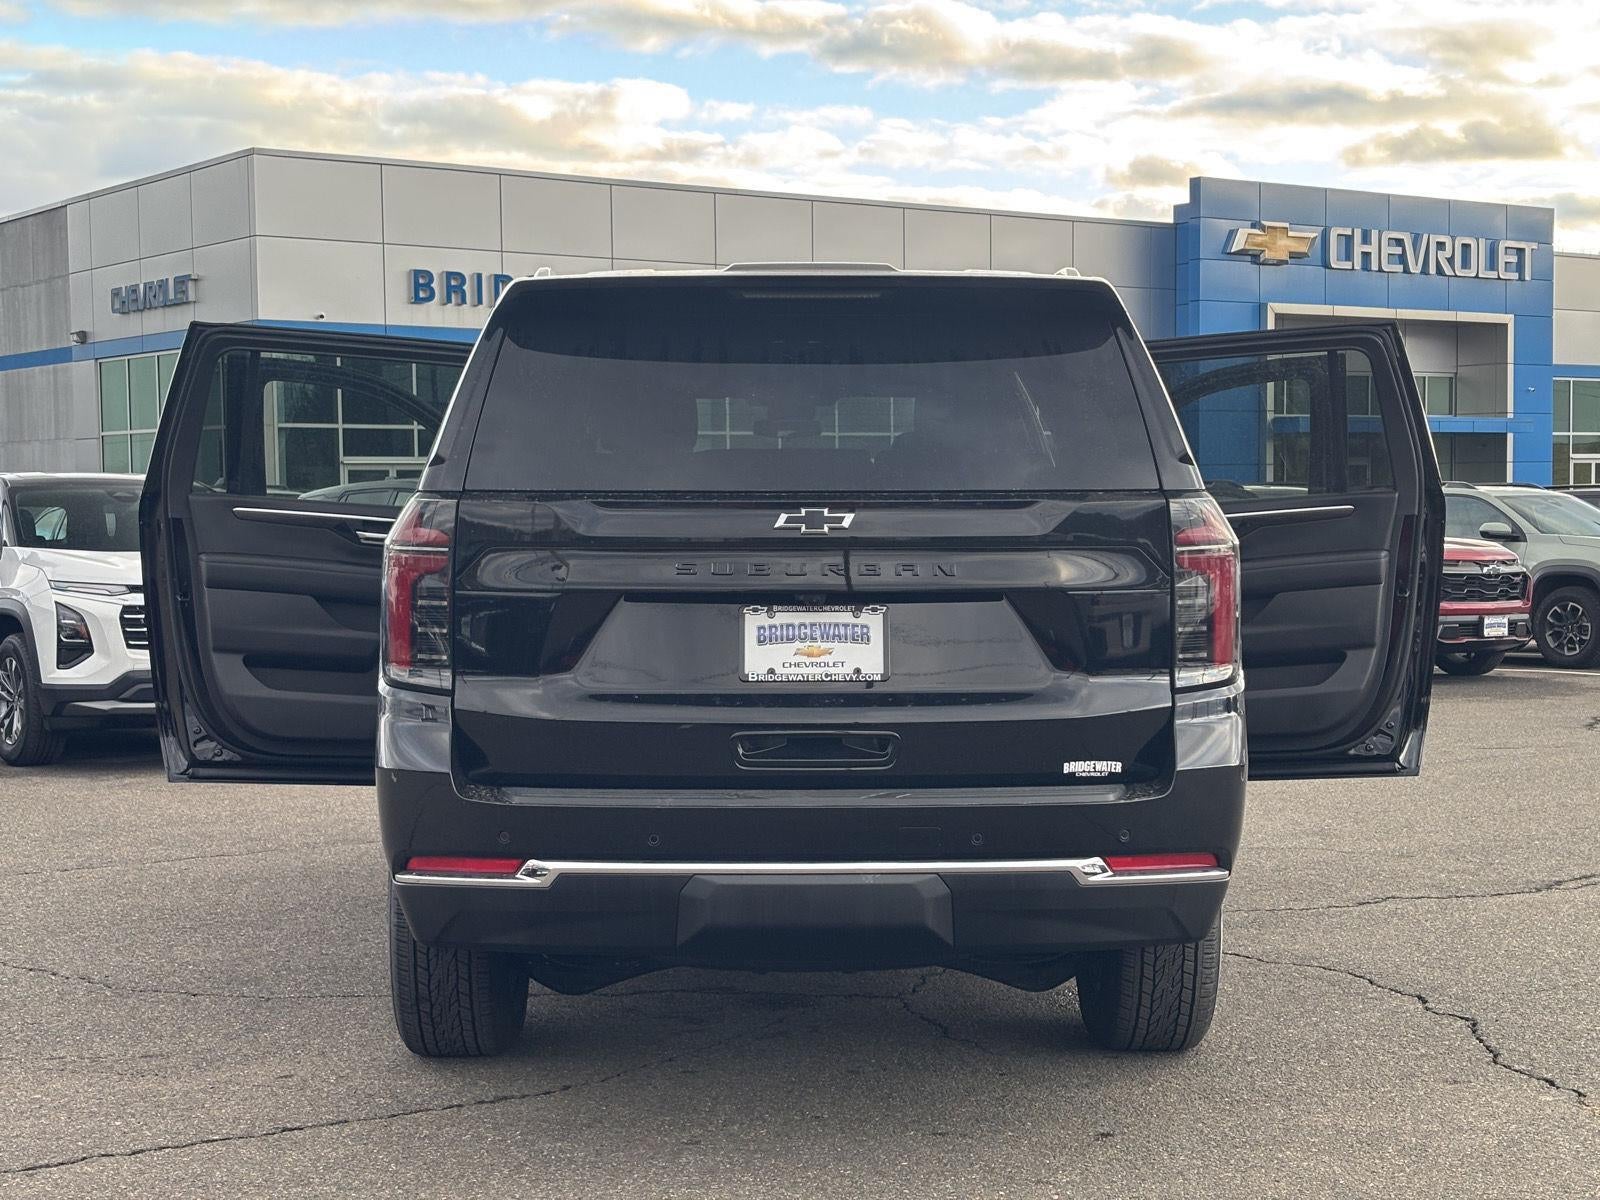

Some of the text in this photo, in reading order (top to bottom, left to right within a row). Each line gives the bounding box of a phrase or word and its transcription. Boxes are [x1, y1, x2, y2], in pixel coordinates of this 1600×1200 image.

[1329, 226, 1538, 281] CHEVROLET
[111, 273, 199, 314] CHEVROLET
[674, 561, 958, 577] SUBURBAN
[756, 622, 871, 646] BRIDGEWATER
[782, 661, 846, 669] CHEVROLET
[1063, 760, 1122, 773] BRIDGEWATER
